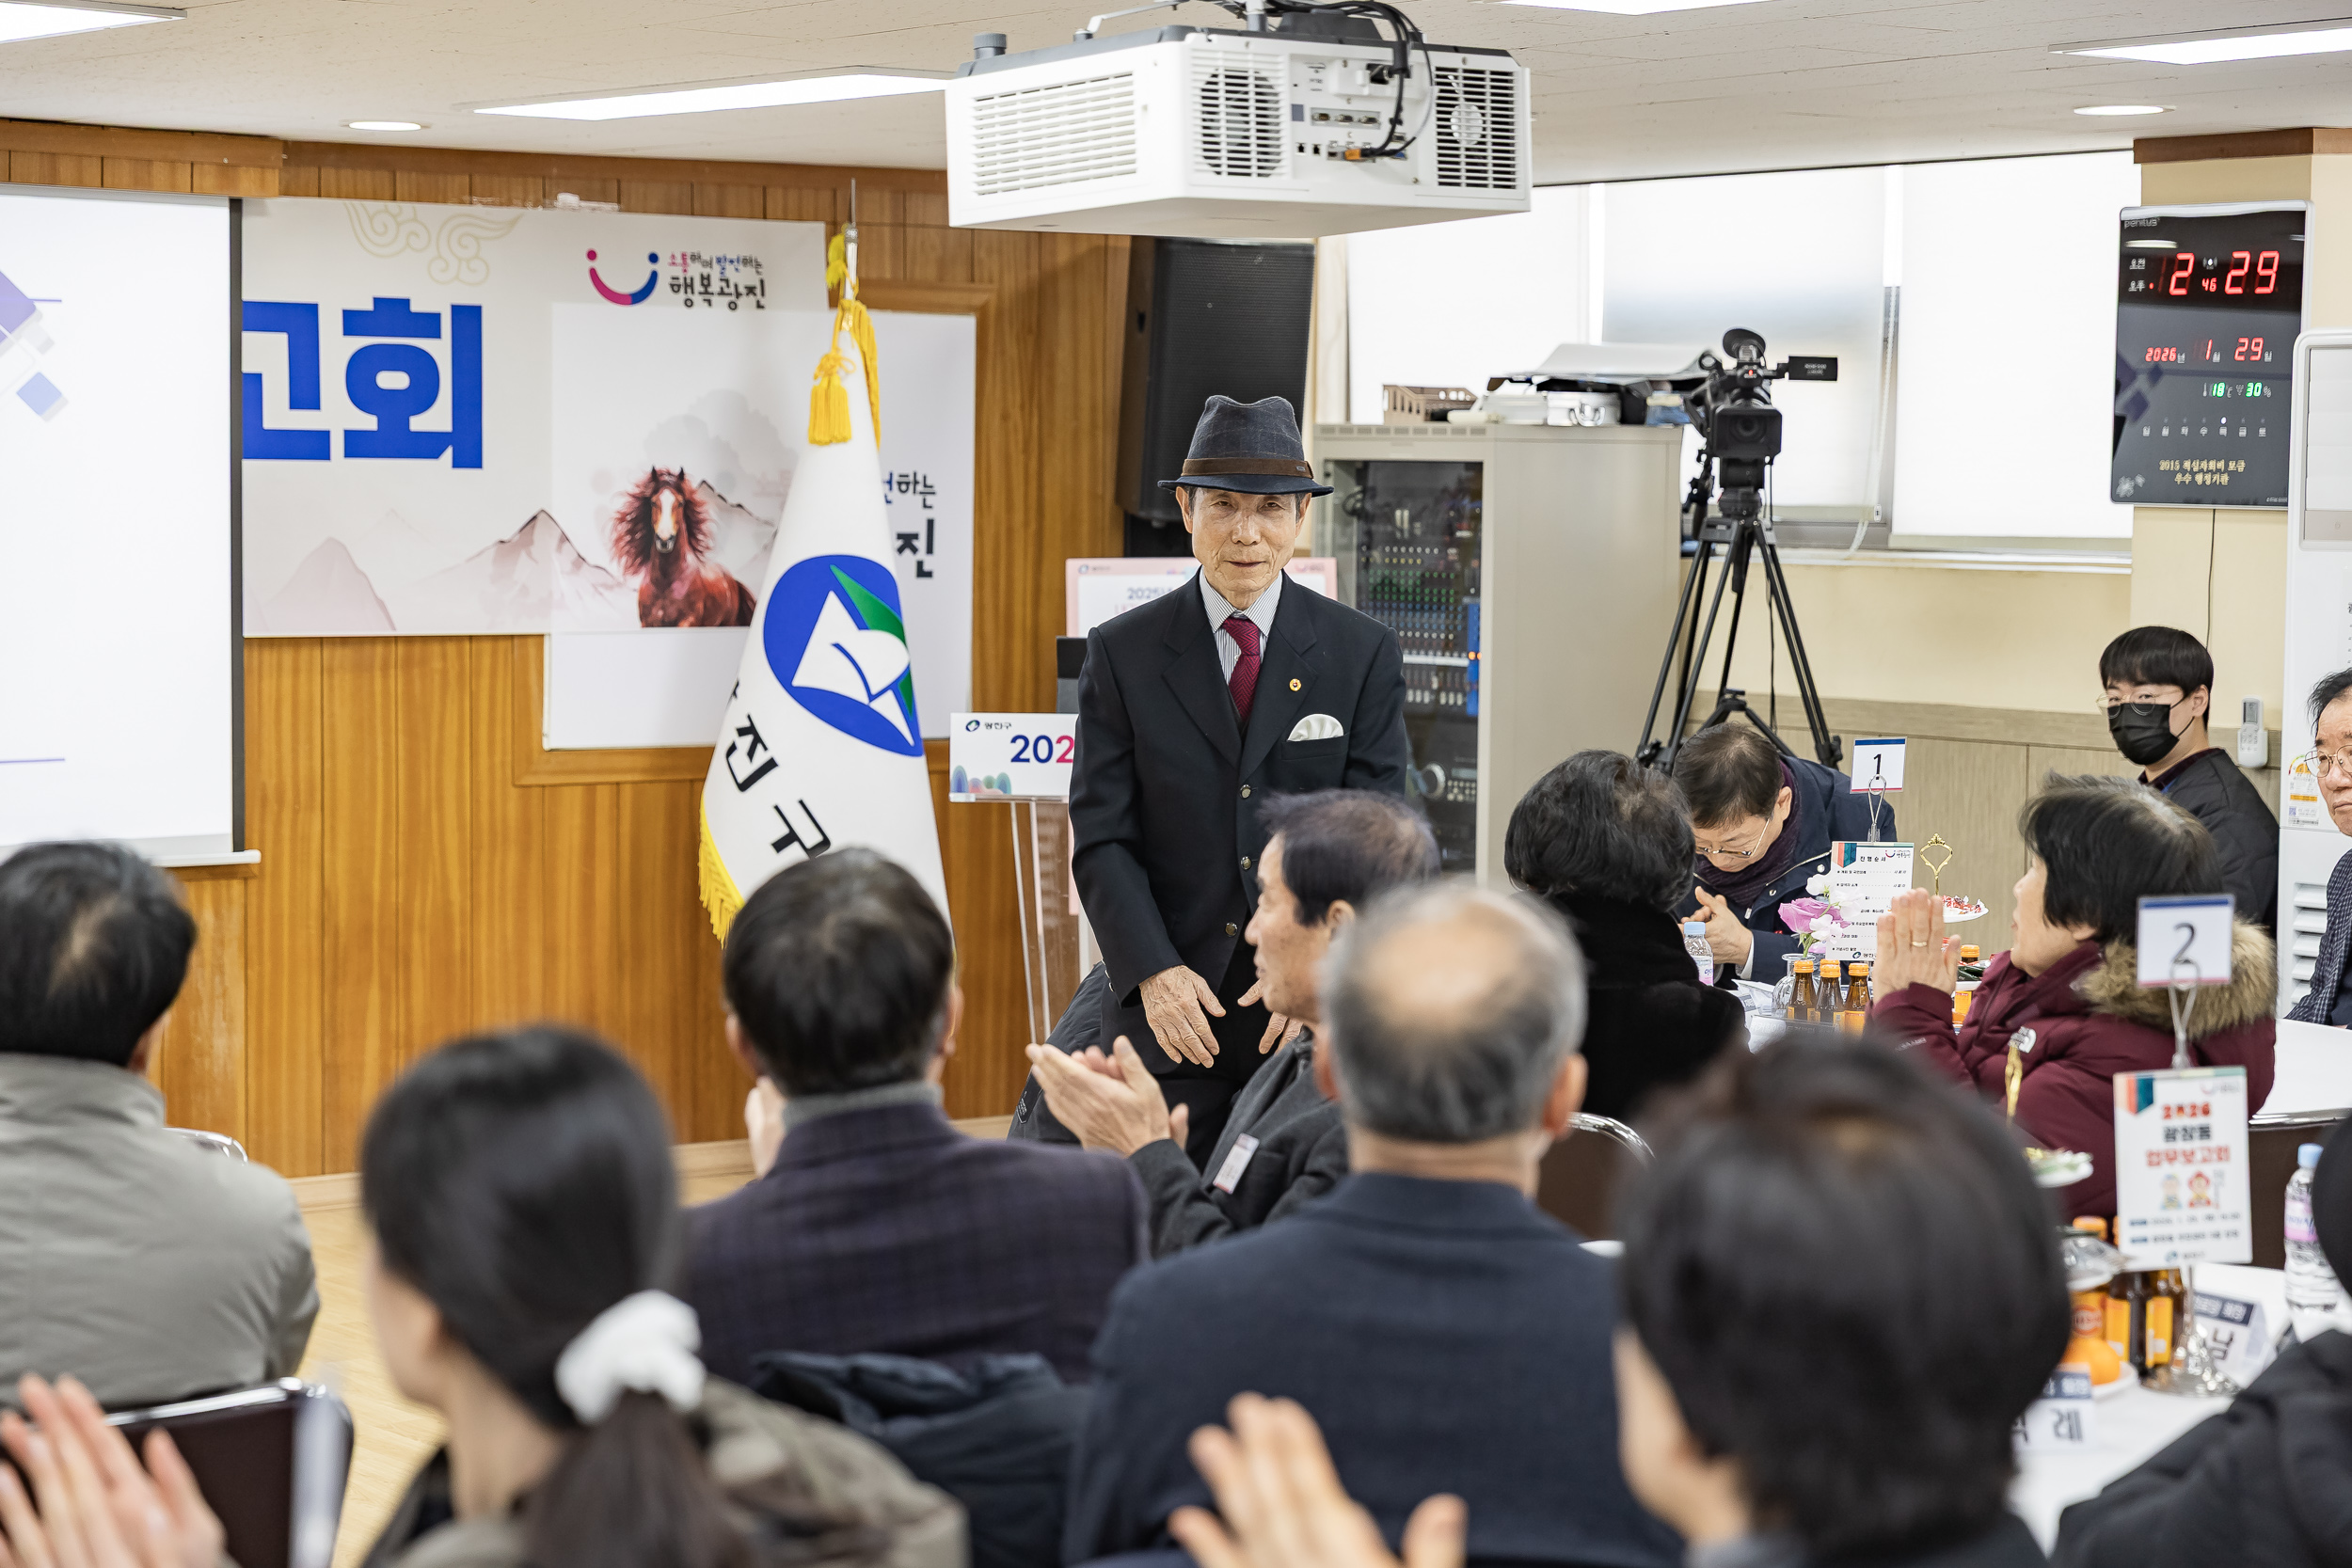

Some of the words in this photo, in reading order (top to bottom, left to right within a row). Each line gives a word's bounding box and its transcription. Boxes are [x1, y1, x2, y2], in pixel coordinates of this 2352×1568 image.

[2129, 258, 2146, 270] 오전
[2169, 252, 2195, 295] 2
[2201, 277, 2217, 293] 46
[2224, 250, 2280, 295] 29
[669, 272, 765, 311] 행복광진
[984, 721, 1012, 731] 광진구
[1873, 753, 1882, 781] 1
[2173, 922, 2196, 965] 2
